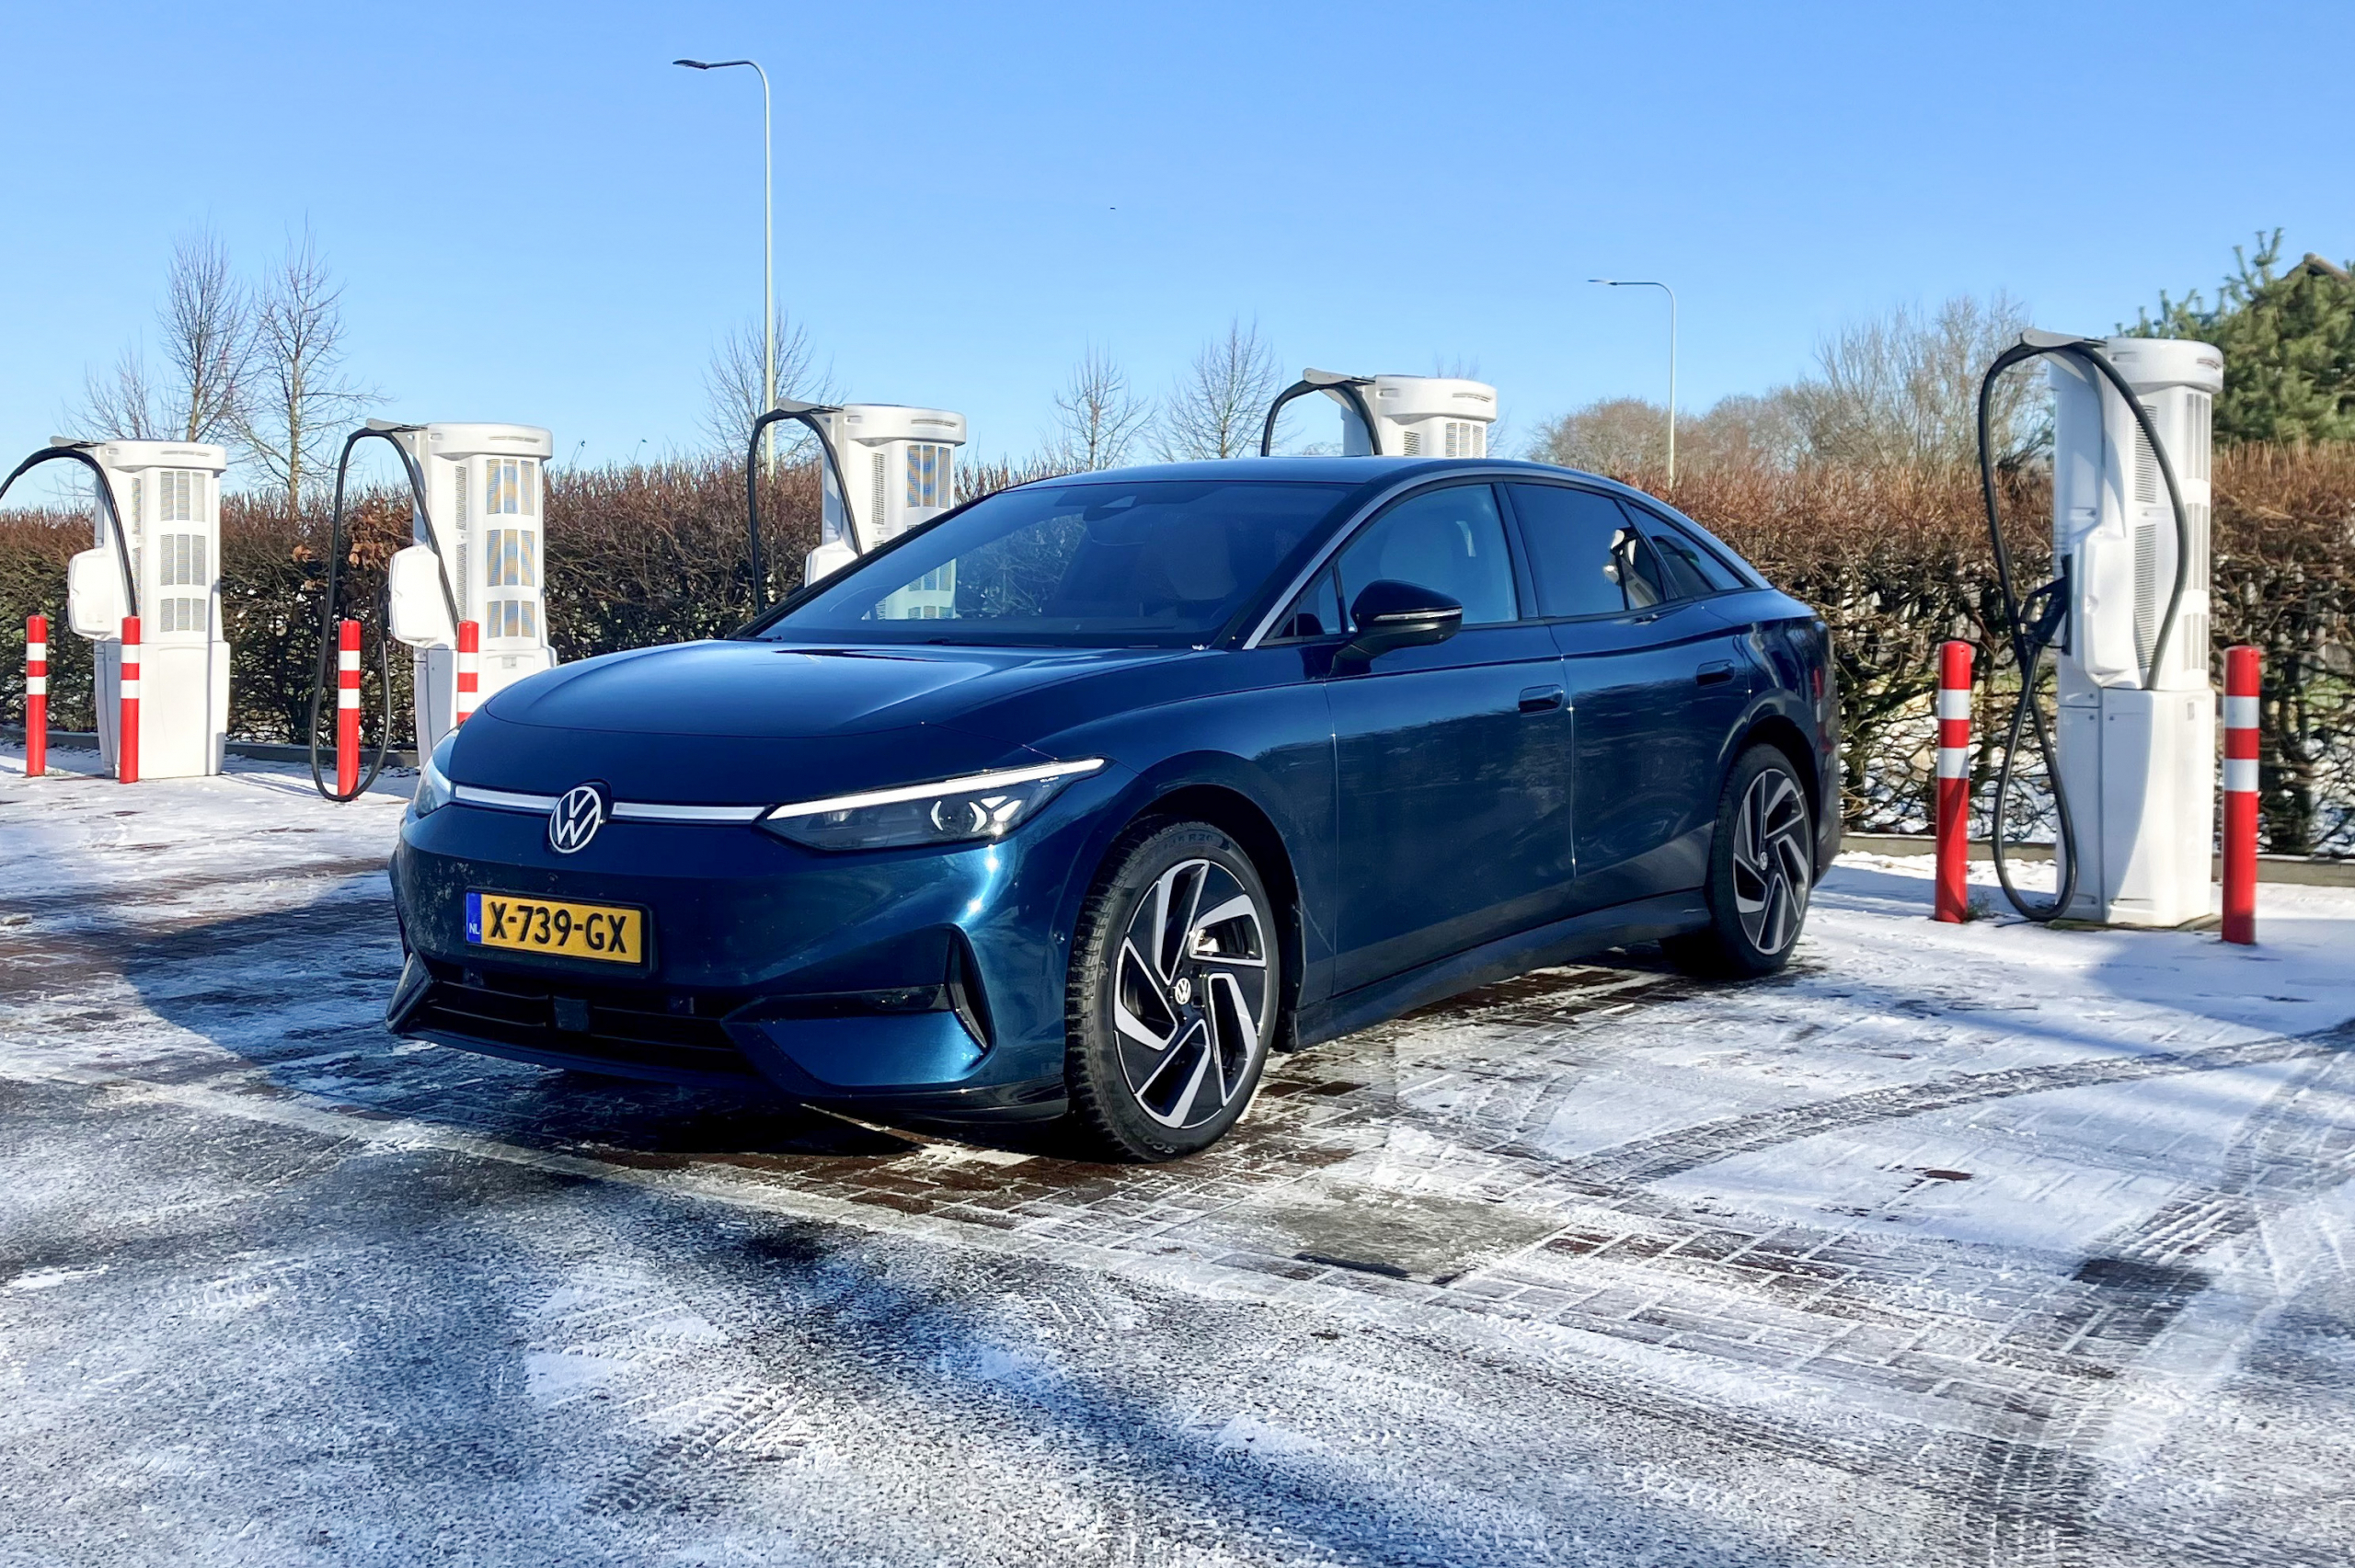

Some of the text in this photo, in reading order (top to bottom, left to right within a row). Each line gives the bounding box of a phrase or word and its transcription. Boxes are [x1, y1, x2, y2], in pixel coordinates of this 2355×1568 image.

[550, 786, 602, 853] VW
[468, 923, 480, 935] NL
[489, 901, 627, 954] X-739-GX
